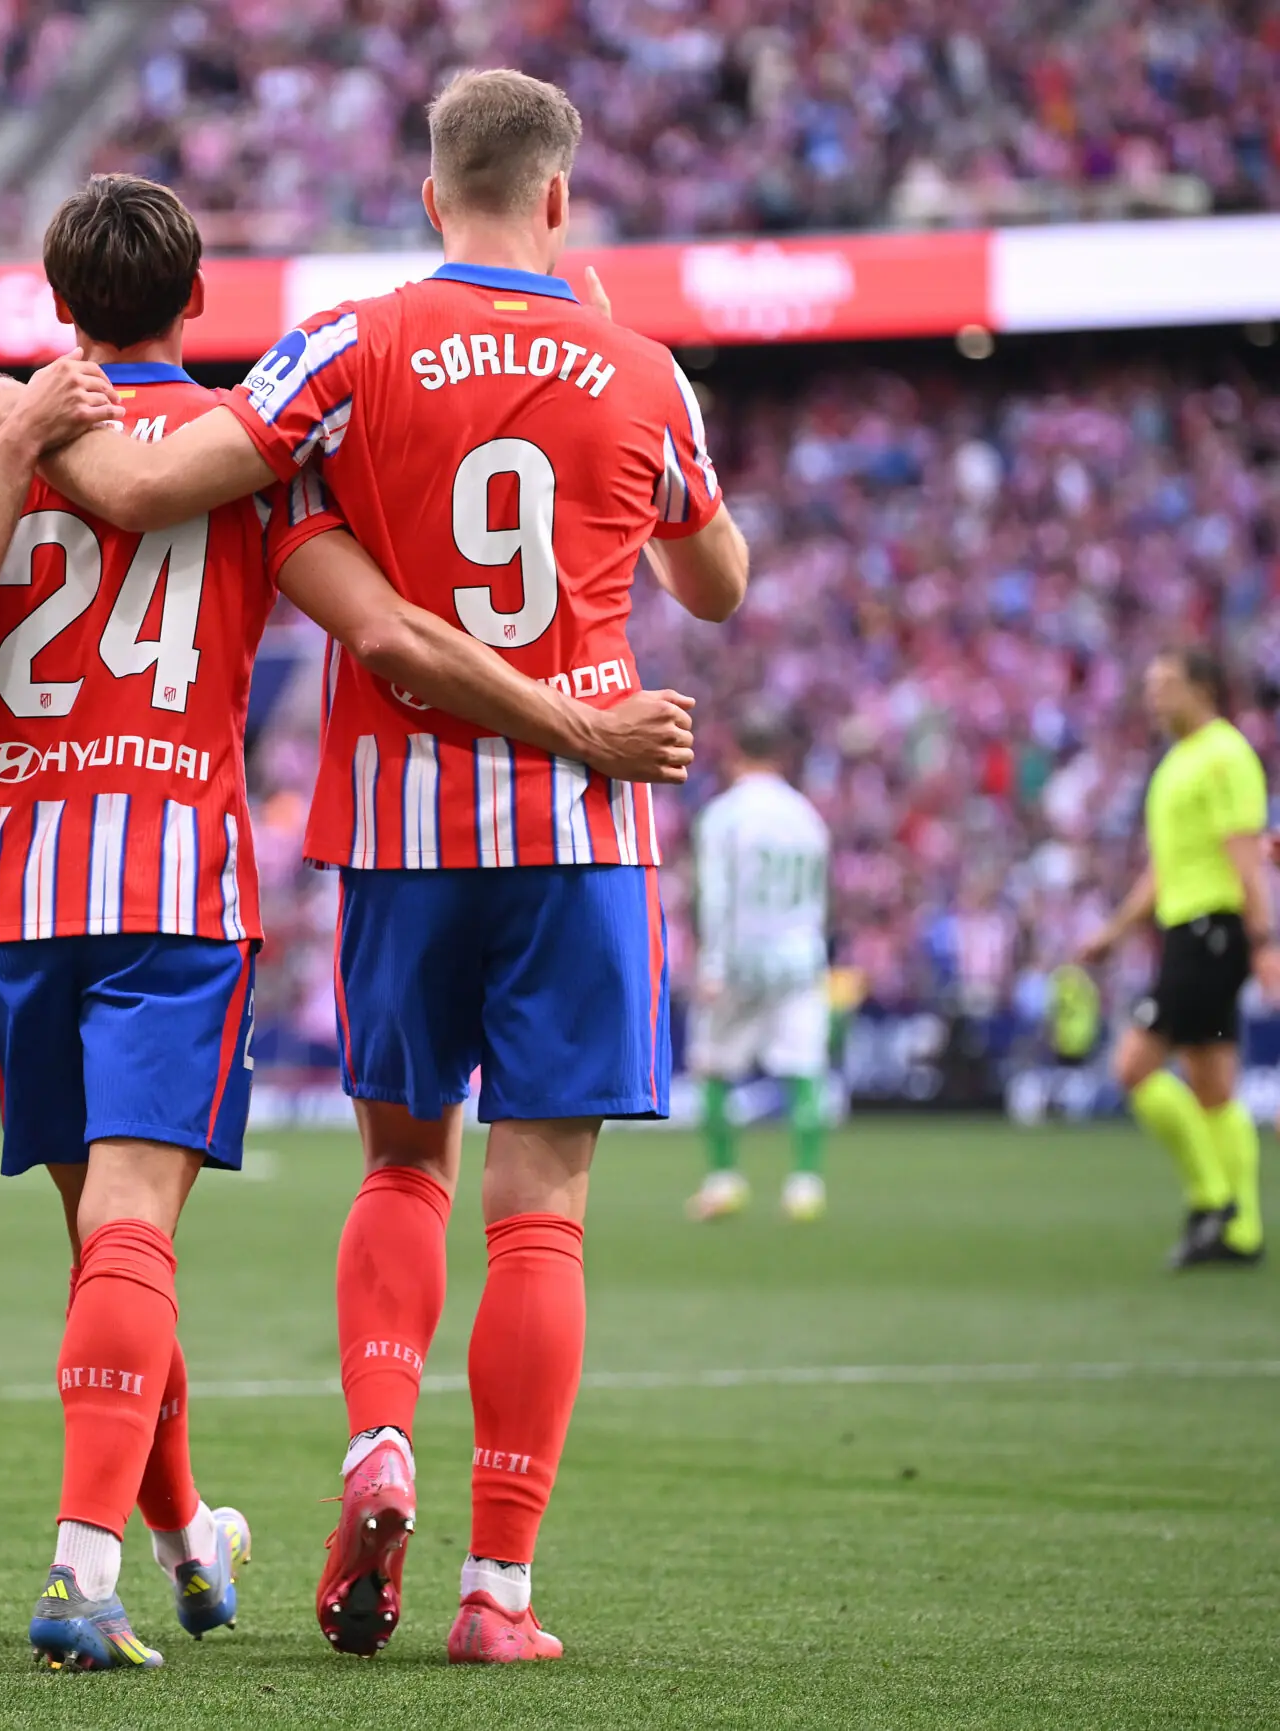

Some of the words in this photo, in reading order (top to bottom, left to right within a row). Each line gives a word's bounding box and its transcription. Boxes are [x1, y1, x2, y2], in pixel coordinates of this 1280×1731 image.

[410, 333, 617, 398] SØRLOTH
[451, 437, 559, 648] 9
[40, 735, 210, 781] HYUNDAI
[61, 1367, 144, 1396] ATLETI
[472, 1447, 531, 1475] TLETI
